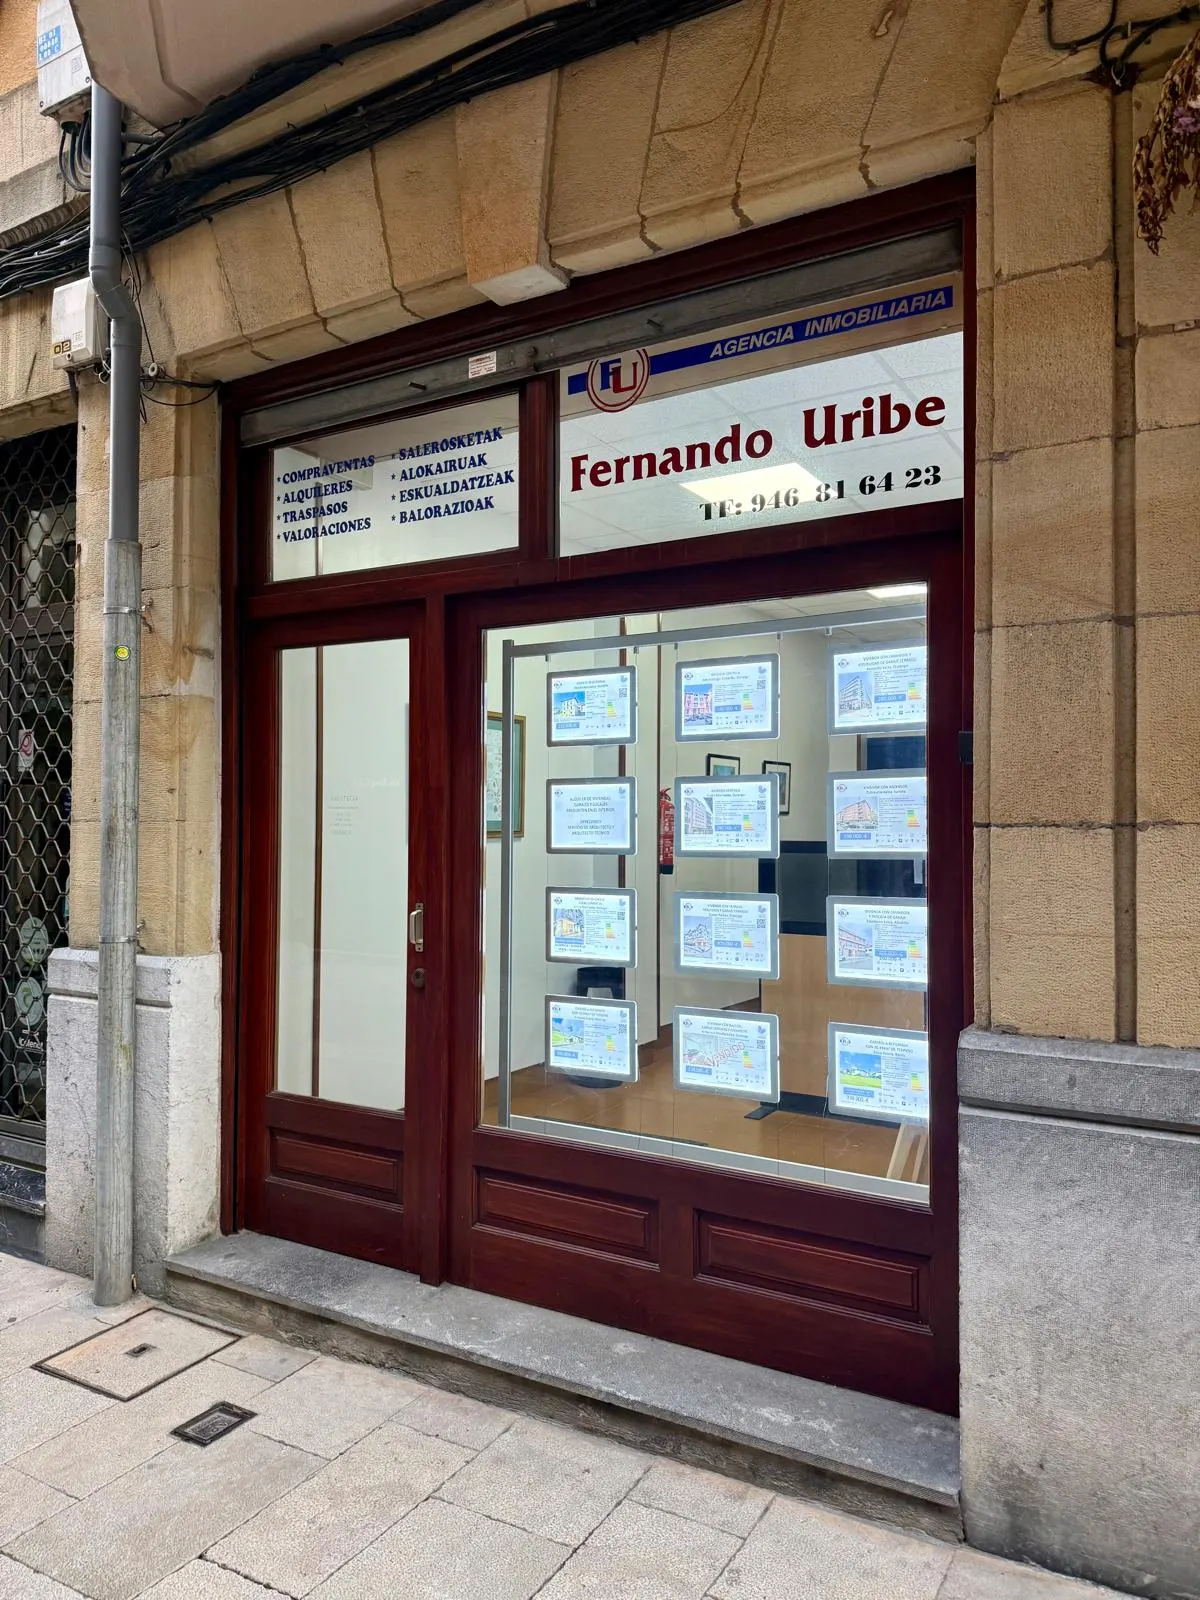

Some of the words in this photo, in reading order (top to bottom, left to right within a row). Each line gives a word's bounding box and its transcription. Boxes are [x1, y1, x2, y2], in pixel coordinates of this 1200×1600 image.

[709, 326, 795, 359] AGENCIA
[804, 290, 946, 337] INMOBILIARIA
[54, 340, 71, 355] 02
[399, 427, 503, 461] SALEROSKETAK
[570, 424, 773, 492] Fernando
[803, 393, 946, 449] Uribe
[282, 455, 375, 485] COMPRAVENTAS
[400, 453, 488, 481] ALOKAIRUAK
[283, 480, 353, 504] ALQUILERES
[399, 470, 515, 502] ESKUALDATZEAK
[751, 487, 799, 513] 946
[815, 479, 847, 503] 81
[859, 471, 894, 496] 64
[905, 465, 942, 489] 23
[283, 501, 348, 523] TRASPASOS
[399, 496, 495, 523] BALORAZIOAK
[283, 517, 371, 543] VALORACIONES
